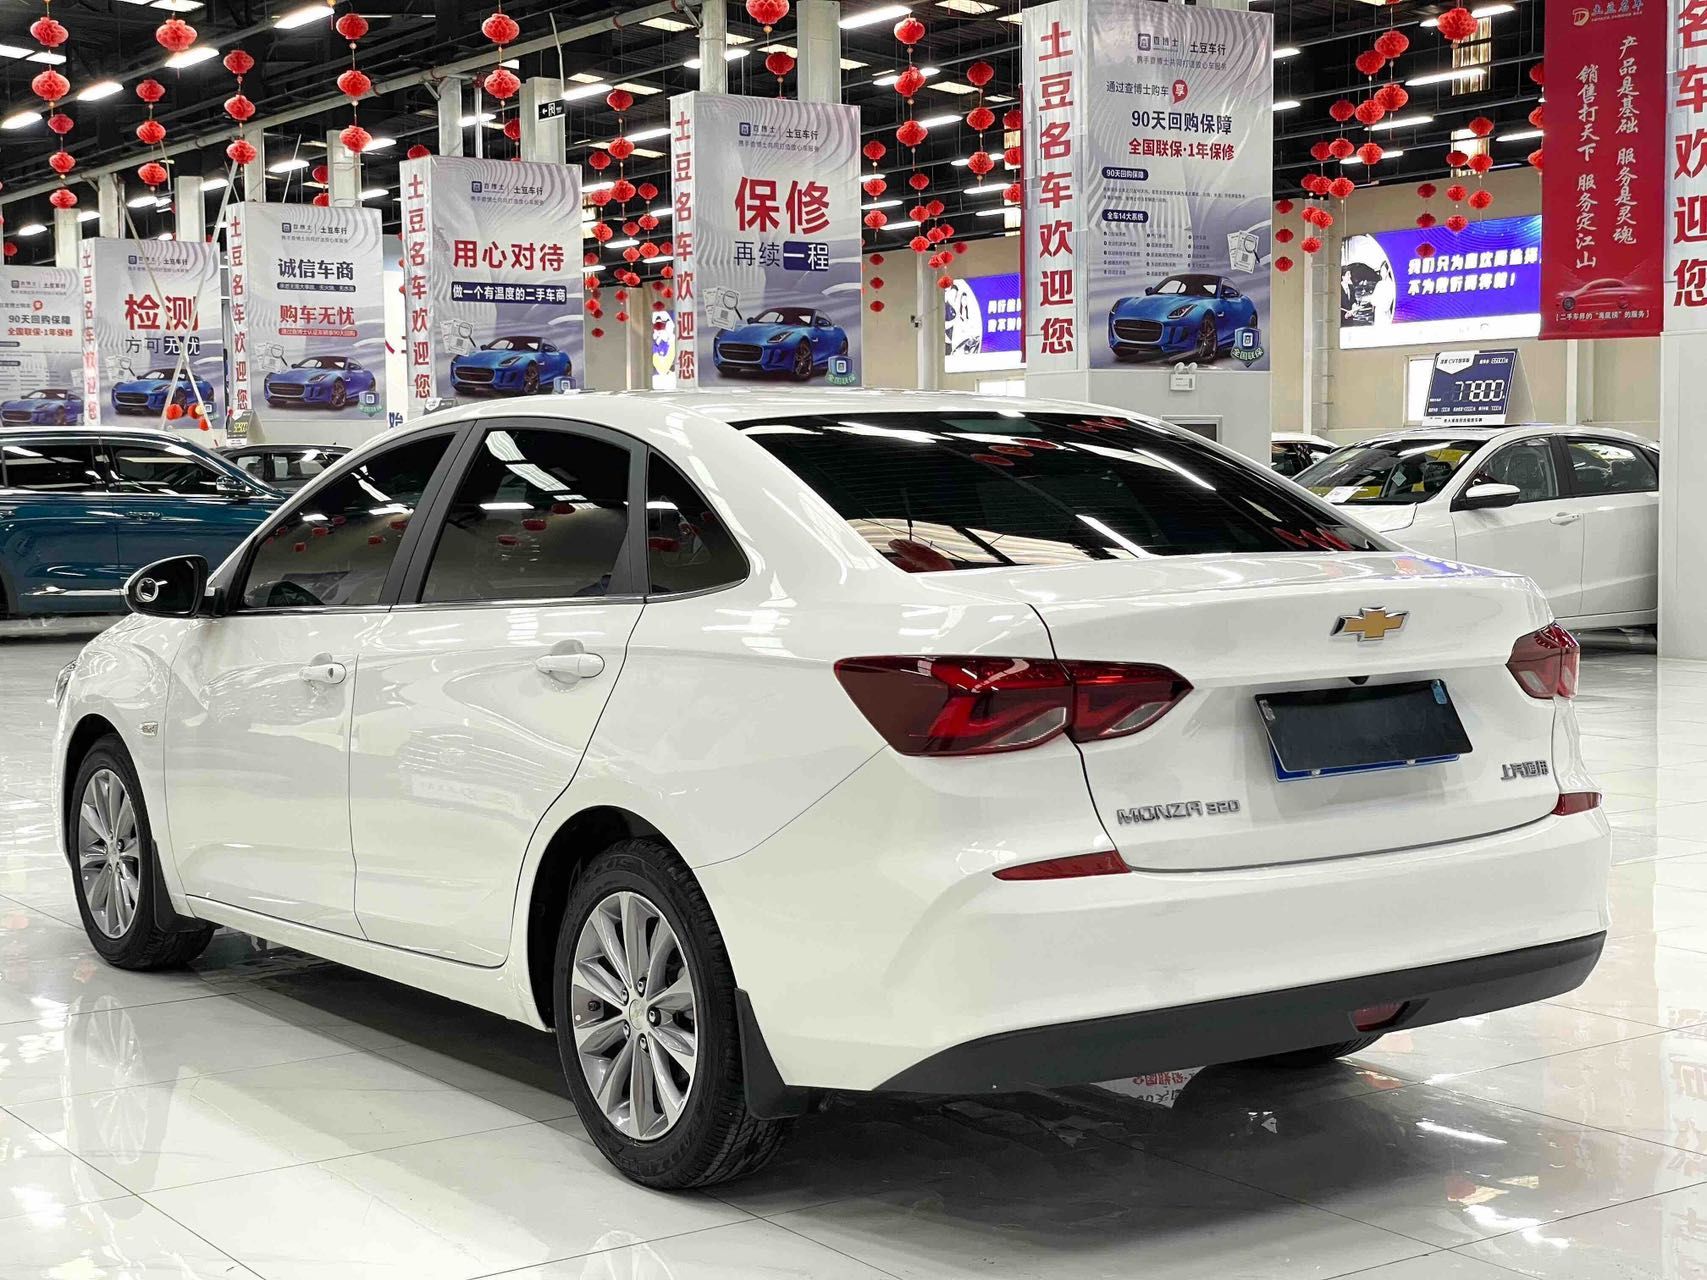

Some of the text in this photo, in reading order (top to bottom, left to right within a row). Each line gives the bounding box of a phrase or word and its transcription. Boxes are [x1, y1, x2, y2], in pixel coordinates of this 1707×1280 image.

[1189, 41, 1226, 56] 土豆车行
[1106, 81, 1169, 97] 通过查博士购车
[1616, 35, 1640, 135] 产品是基础
[1131, 110, 1233, 136] 90天回购保障
[1129, 137, 1235, 161] 全国联保·1年保修
[1039, 21, 1074, 355] 土豆名车欢迎您
[1613, 147, 1638, 245] 服务是灵魂
[734, 176, 831, 235] 保修
[1576, 173, 1598, 269] 服务定江山
[453, 240, 565, 272] 用心对待
[674, 111, 696, 381] 土豆名车欢迎您
[733, 240, 829, 271] 再续一程
[277, 258, 355, 282] 诚信车商
[407, 174, 431, 398] 土豆名车欢迎您
[452, 284, 567, 303] 做一个有温度的二手车商
[125, 293, 200, 332] 检测
[229, 216, 249, 410] 土豆名车欢迎您
[279, 305, 355, 325] 购车无忧
[126, 336, 199, 354] 方可无忧
[1455, 380, 1505, 402] 77800
[1116, 800, 1203, 824] MONZA
